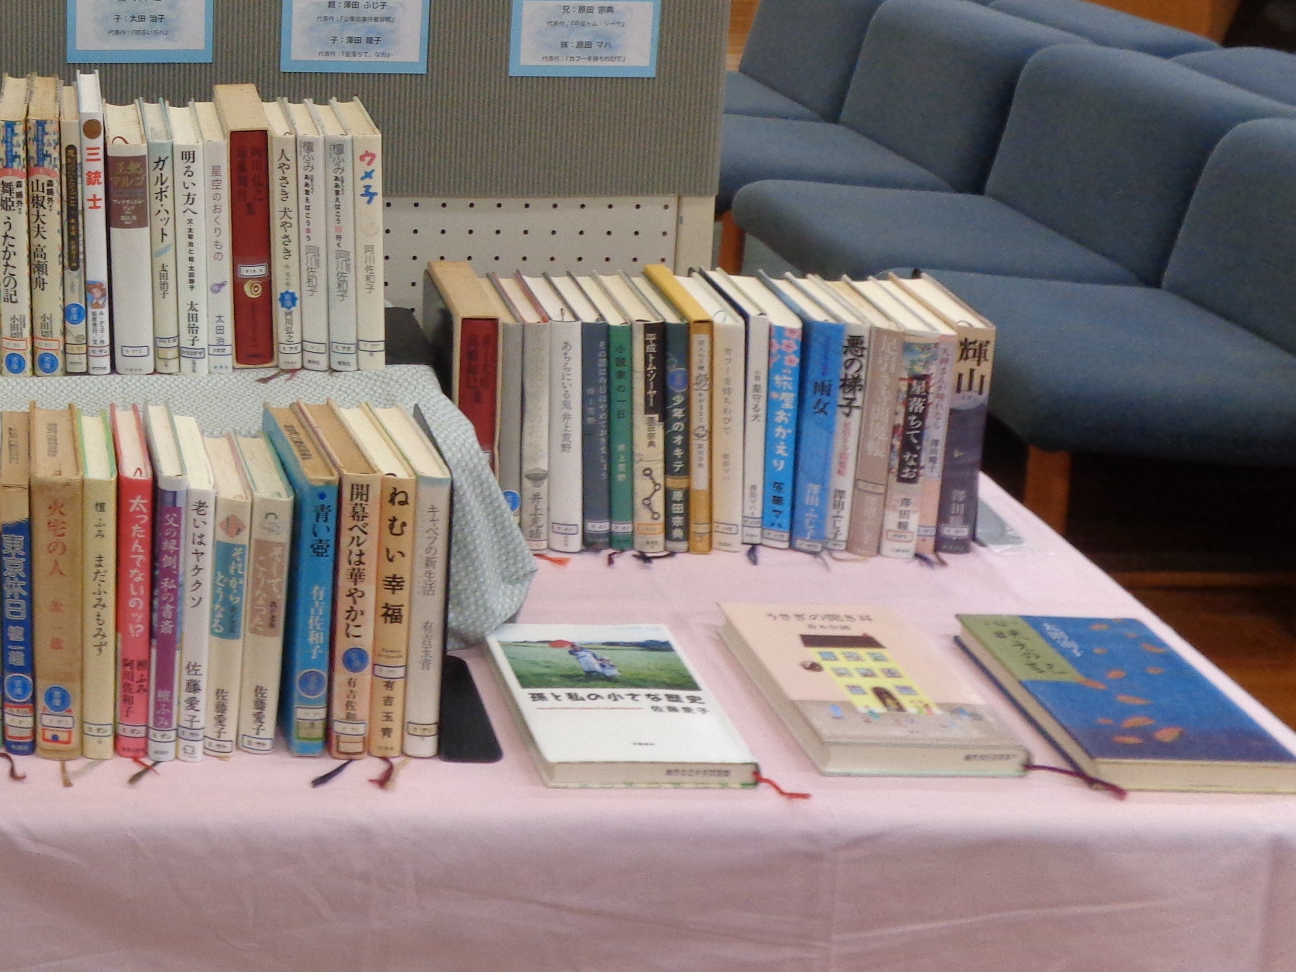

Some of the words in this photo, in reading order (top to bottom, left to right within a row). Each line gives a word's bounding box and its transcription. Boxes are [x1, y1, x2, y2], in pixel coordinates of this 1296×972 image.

[149, 14, 165, 23] 治子
[363, 0, 387, 9] ふじ子
[597, 40, 612, 50] マハ
[85, 146, 102, 210] 三銃士
[152, 155, 172, 244] ガルボ・ハット
[181, 150, 198, 216] 明るい方へ
[359, 150, 379, 205] ウメ子
[210, 165, 224, 262] 星空のおくりもの
[3, 216, 20, 304] うたかたの記
[187, 301, 199, 347] 太田治子
[812, 379, 832, 416] 雨女
[956, 338, 989, 396] 輝山
[670, 393, 685, 472] 少年のオキテ
[190, 499, 208, 609] 老いはヤケクソ
[345, 483, 370, 640] 開幕ベルは華やかに
[380, 487, 409, 625] ねむい幸福
[184, 661, 202, 729] 佐藤愛子
[528, 691, 707, 705] 孫と私の小さな歴史
